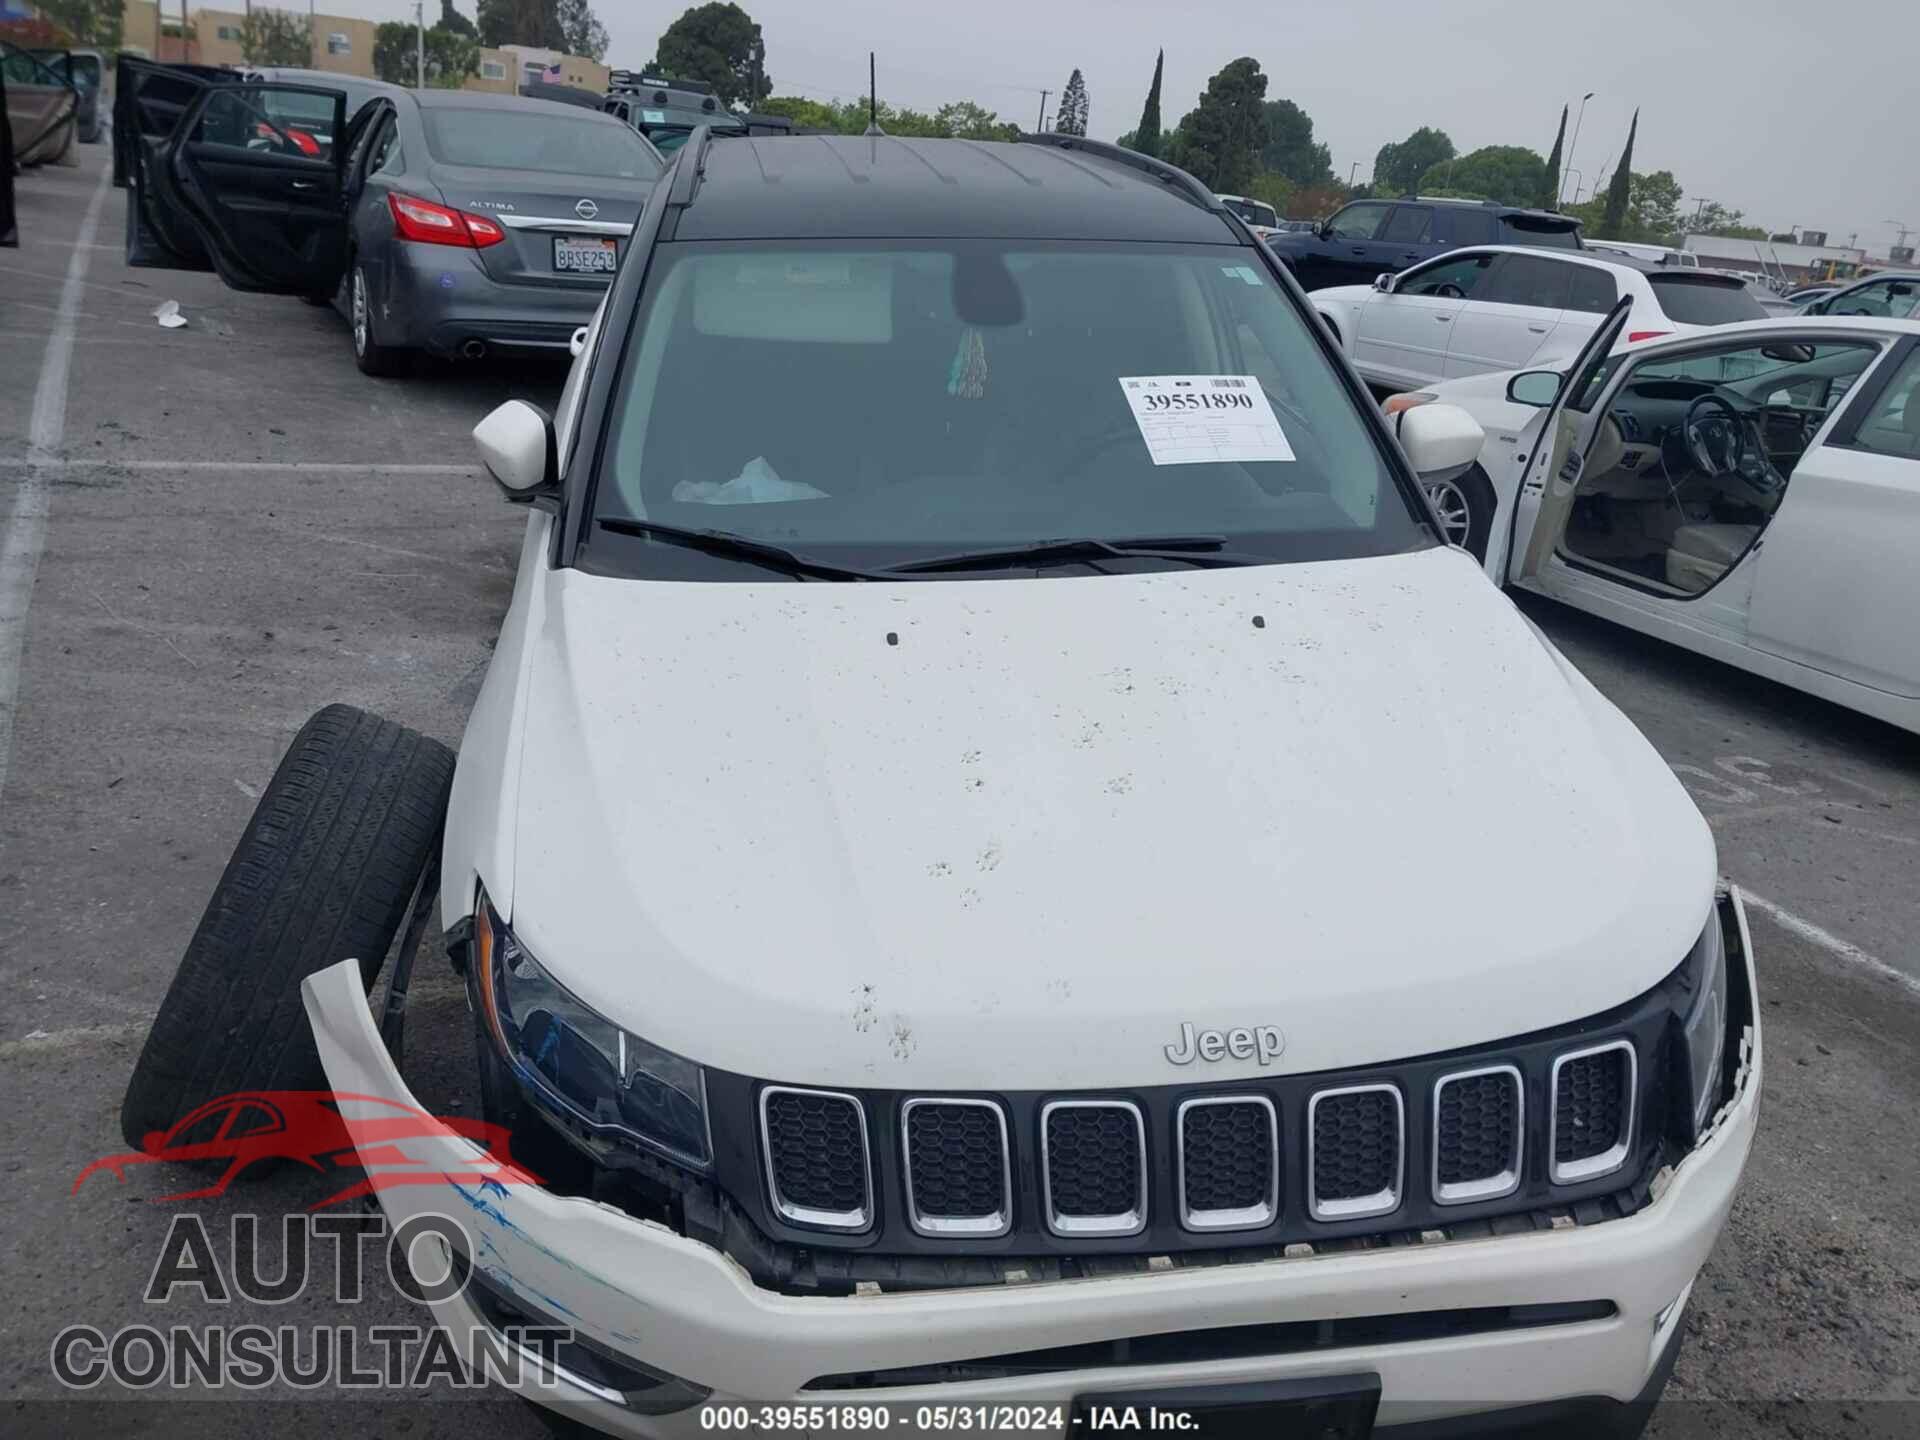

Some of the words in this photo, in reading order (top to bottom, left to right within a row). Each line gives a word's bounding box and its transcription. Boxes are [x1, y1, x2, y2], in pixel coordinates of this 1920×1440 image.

[469, 200, 515, 212] ALTIMA
[1143, 392, 1254, 411] 39551890
[1164, 1021, 1286, 1066] Jeep
